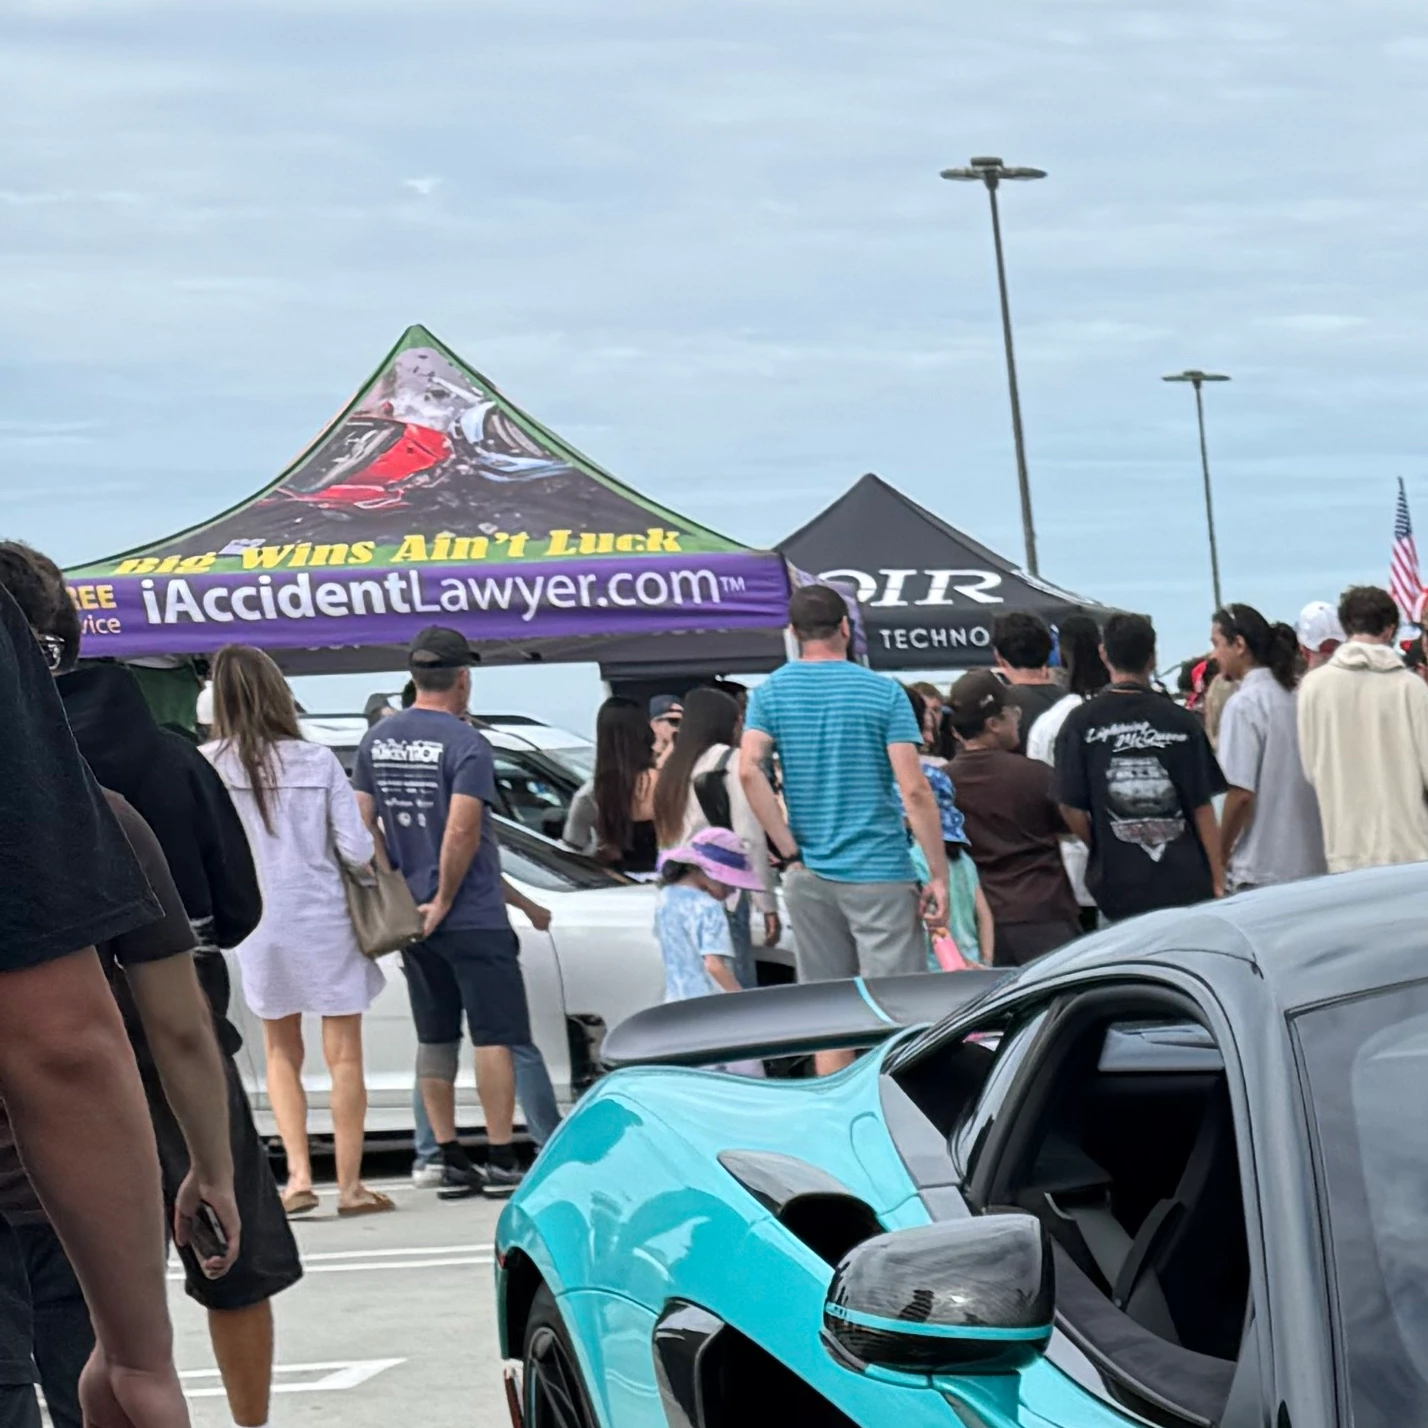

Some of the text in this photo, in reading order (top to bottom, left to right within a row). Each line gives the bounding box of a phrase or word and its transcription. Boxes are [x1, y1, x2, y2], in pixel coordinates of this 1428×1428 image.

[113, 528, 682, 575] Big Wins Ain't Luck
[66, 584, 117, 610] REE
[80, 614, 121, 635] vice
